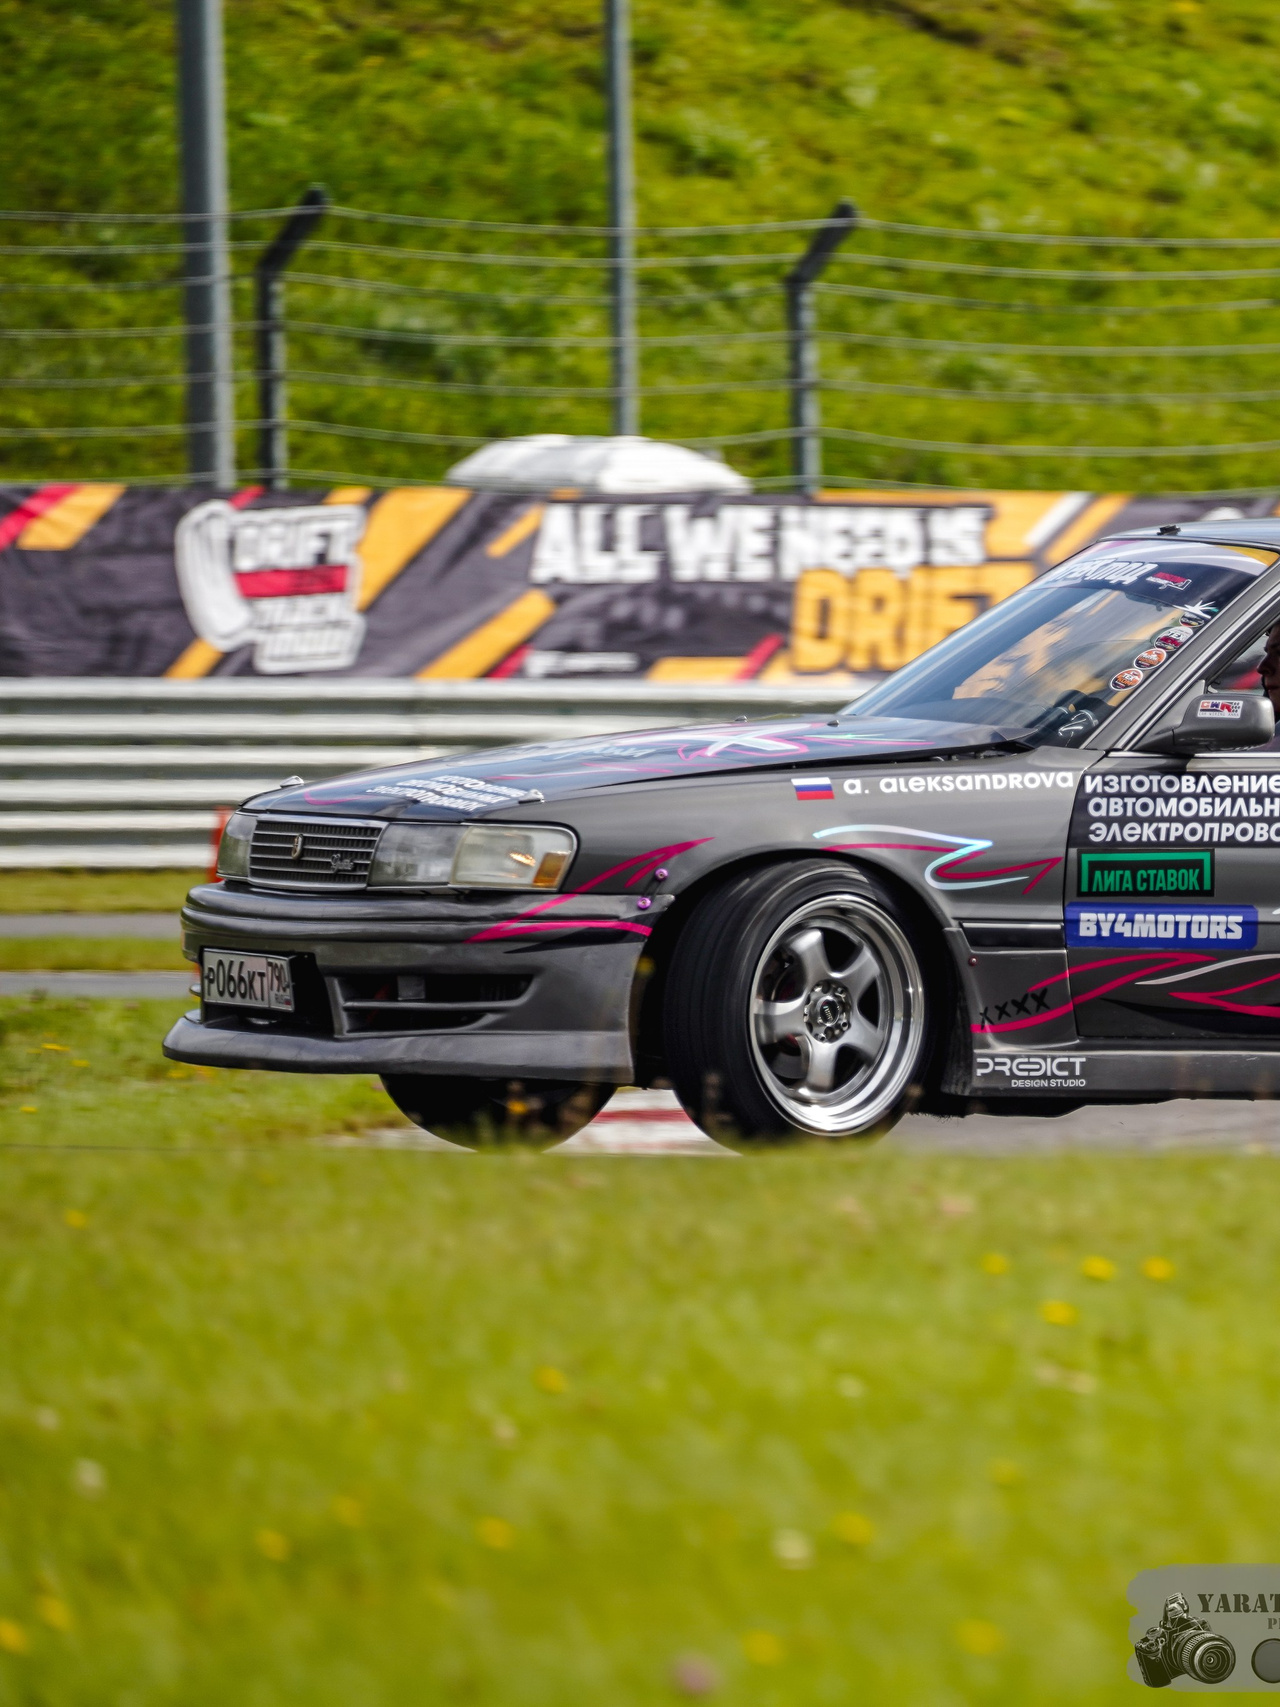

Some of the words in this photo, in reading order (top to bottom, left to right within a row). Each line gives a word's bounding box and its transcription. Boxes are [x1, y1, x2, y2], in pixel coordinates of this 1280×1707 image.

[531, 504, 664, 584] ALL
[664, 504, 776, 582] WE
[778, 504, 922, 578] NEED
[925, 506, 990, 566] IS
[1092, 870, 1132, 892] ЛИГА
[1136, 869, 1200, 892] СТАВОК
[1079, 912, 1244, 940] BY4MOTORS
[267, 961, 287, 992] 790
[976, 1057, 1087, 1077] PREDICT
[1011, 1079, 1048, 1087] DESIGN
[1050, 1079, 1086, 1087] STUDIO
